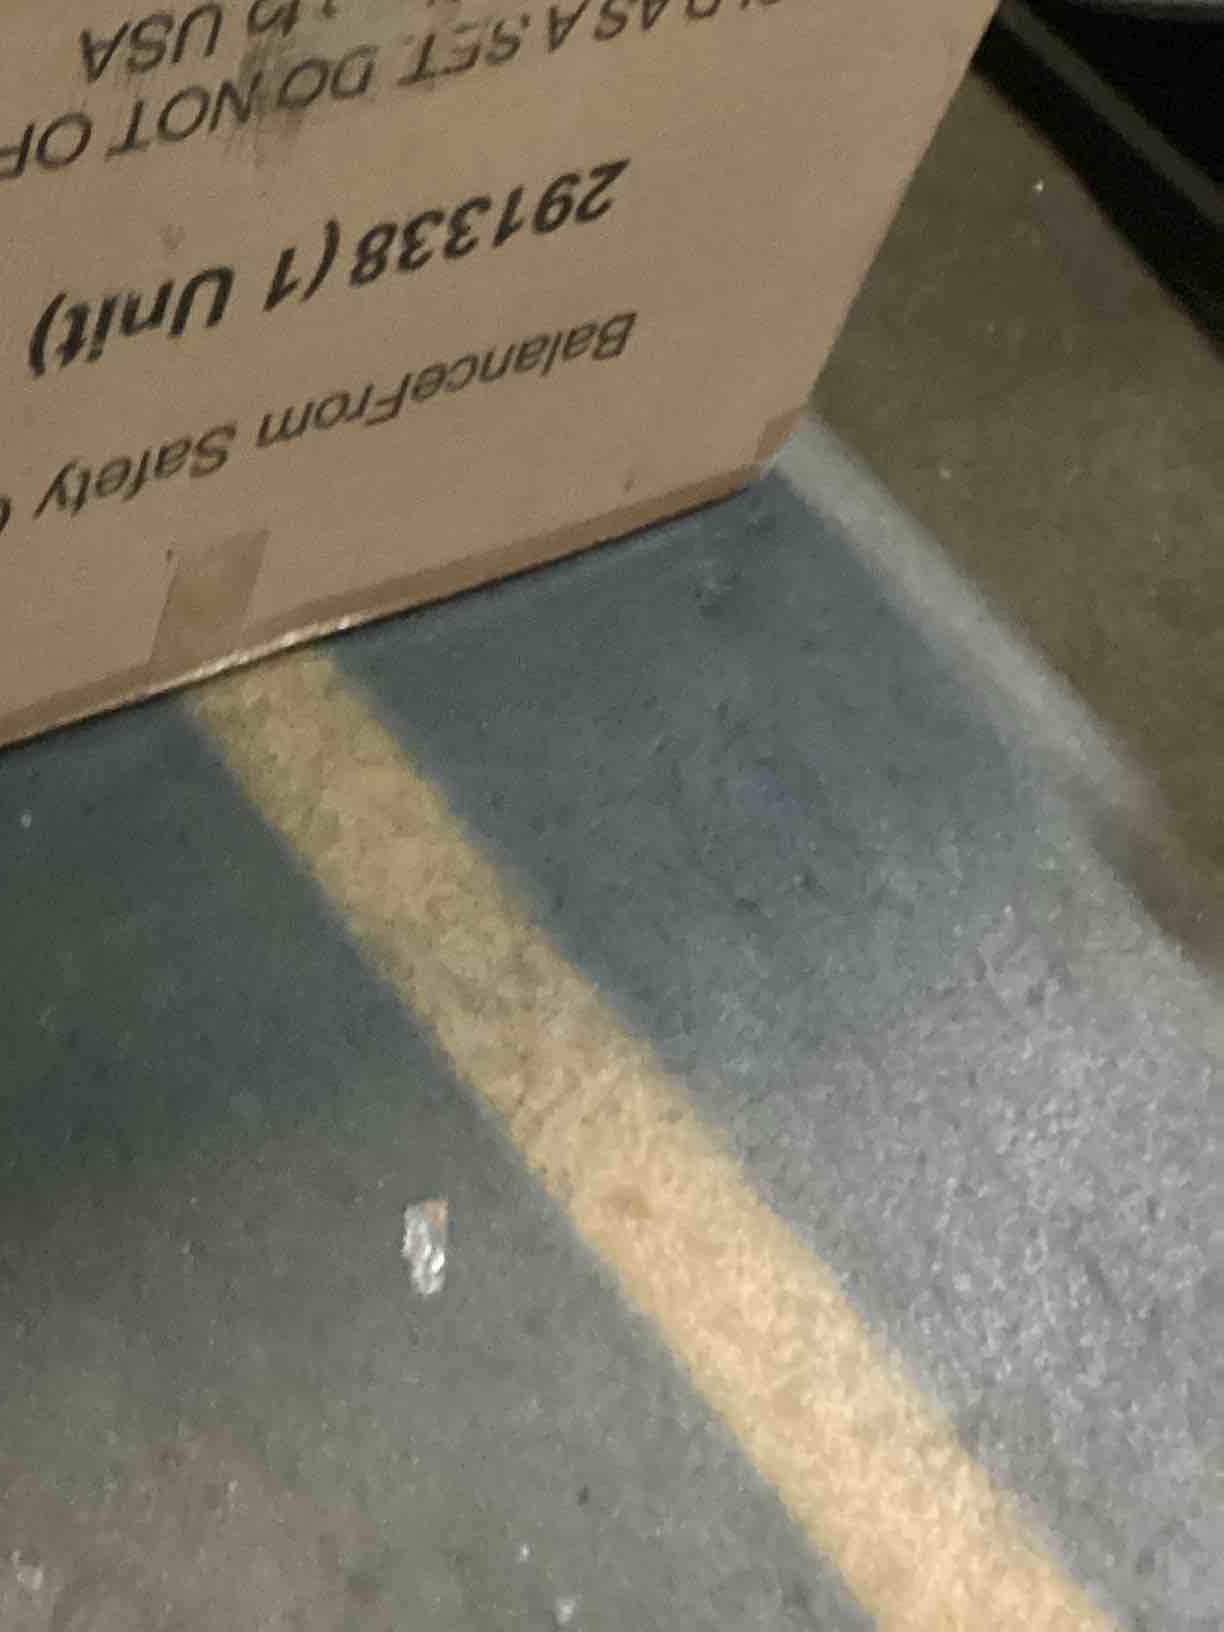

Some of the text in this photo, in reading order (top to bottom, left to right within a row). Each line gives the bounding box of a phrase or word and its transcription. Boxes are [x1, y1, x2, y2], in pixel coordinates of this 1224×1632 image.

[79, 4, 223, 80] USA
[538, 5, 581, 56] A
[103, 73, 265, 156] NOT
[273, 44, 379, 117] DO
[24, 271, 232, 378] Unit)
[257, 311, 638, 451] BalanceFrom
[34, 423, 237, 517] Safety
